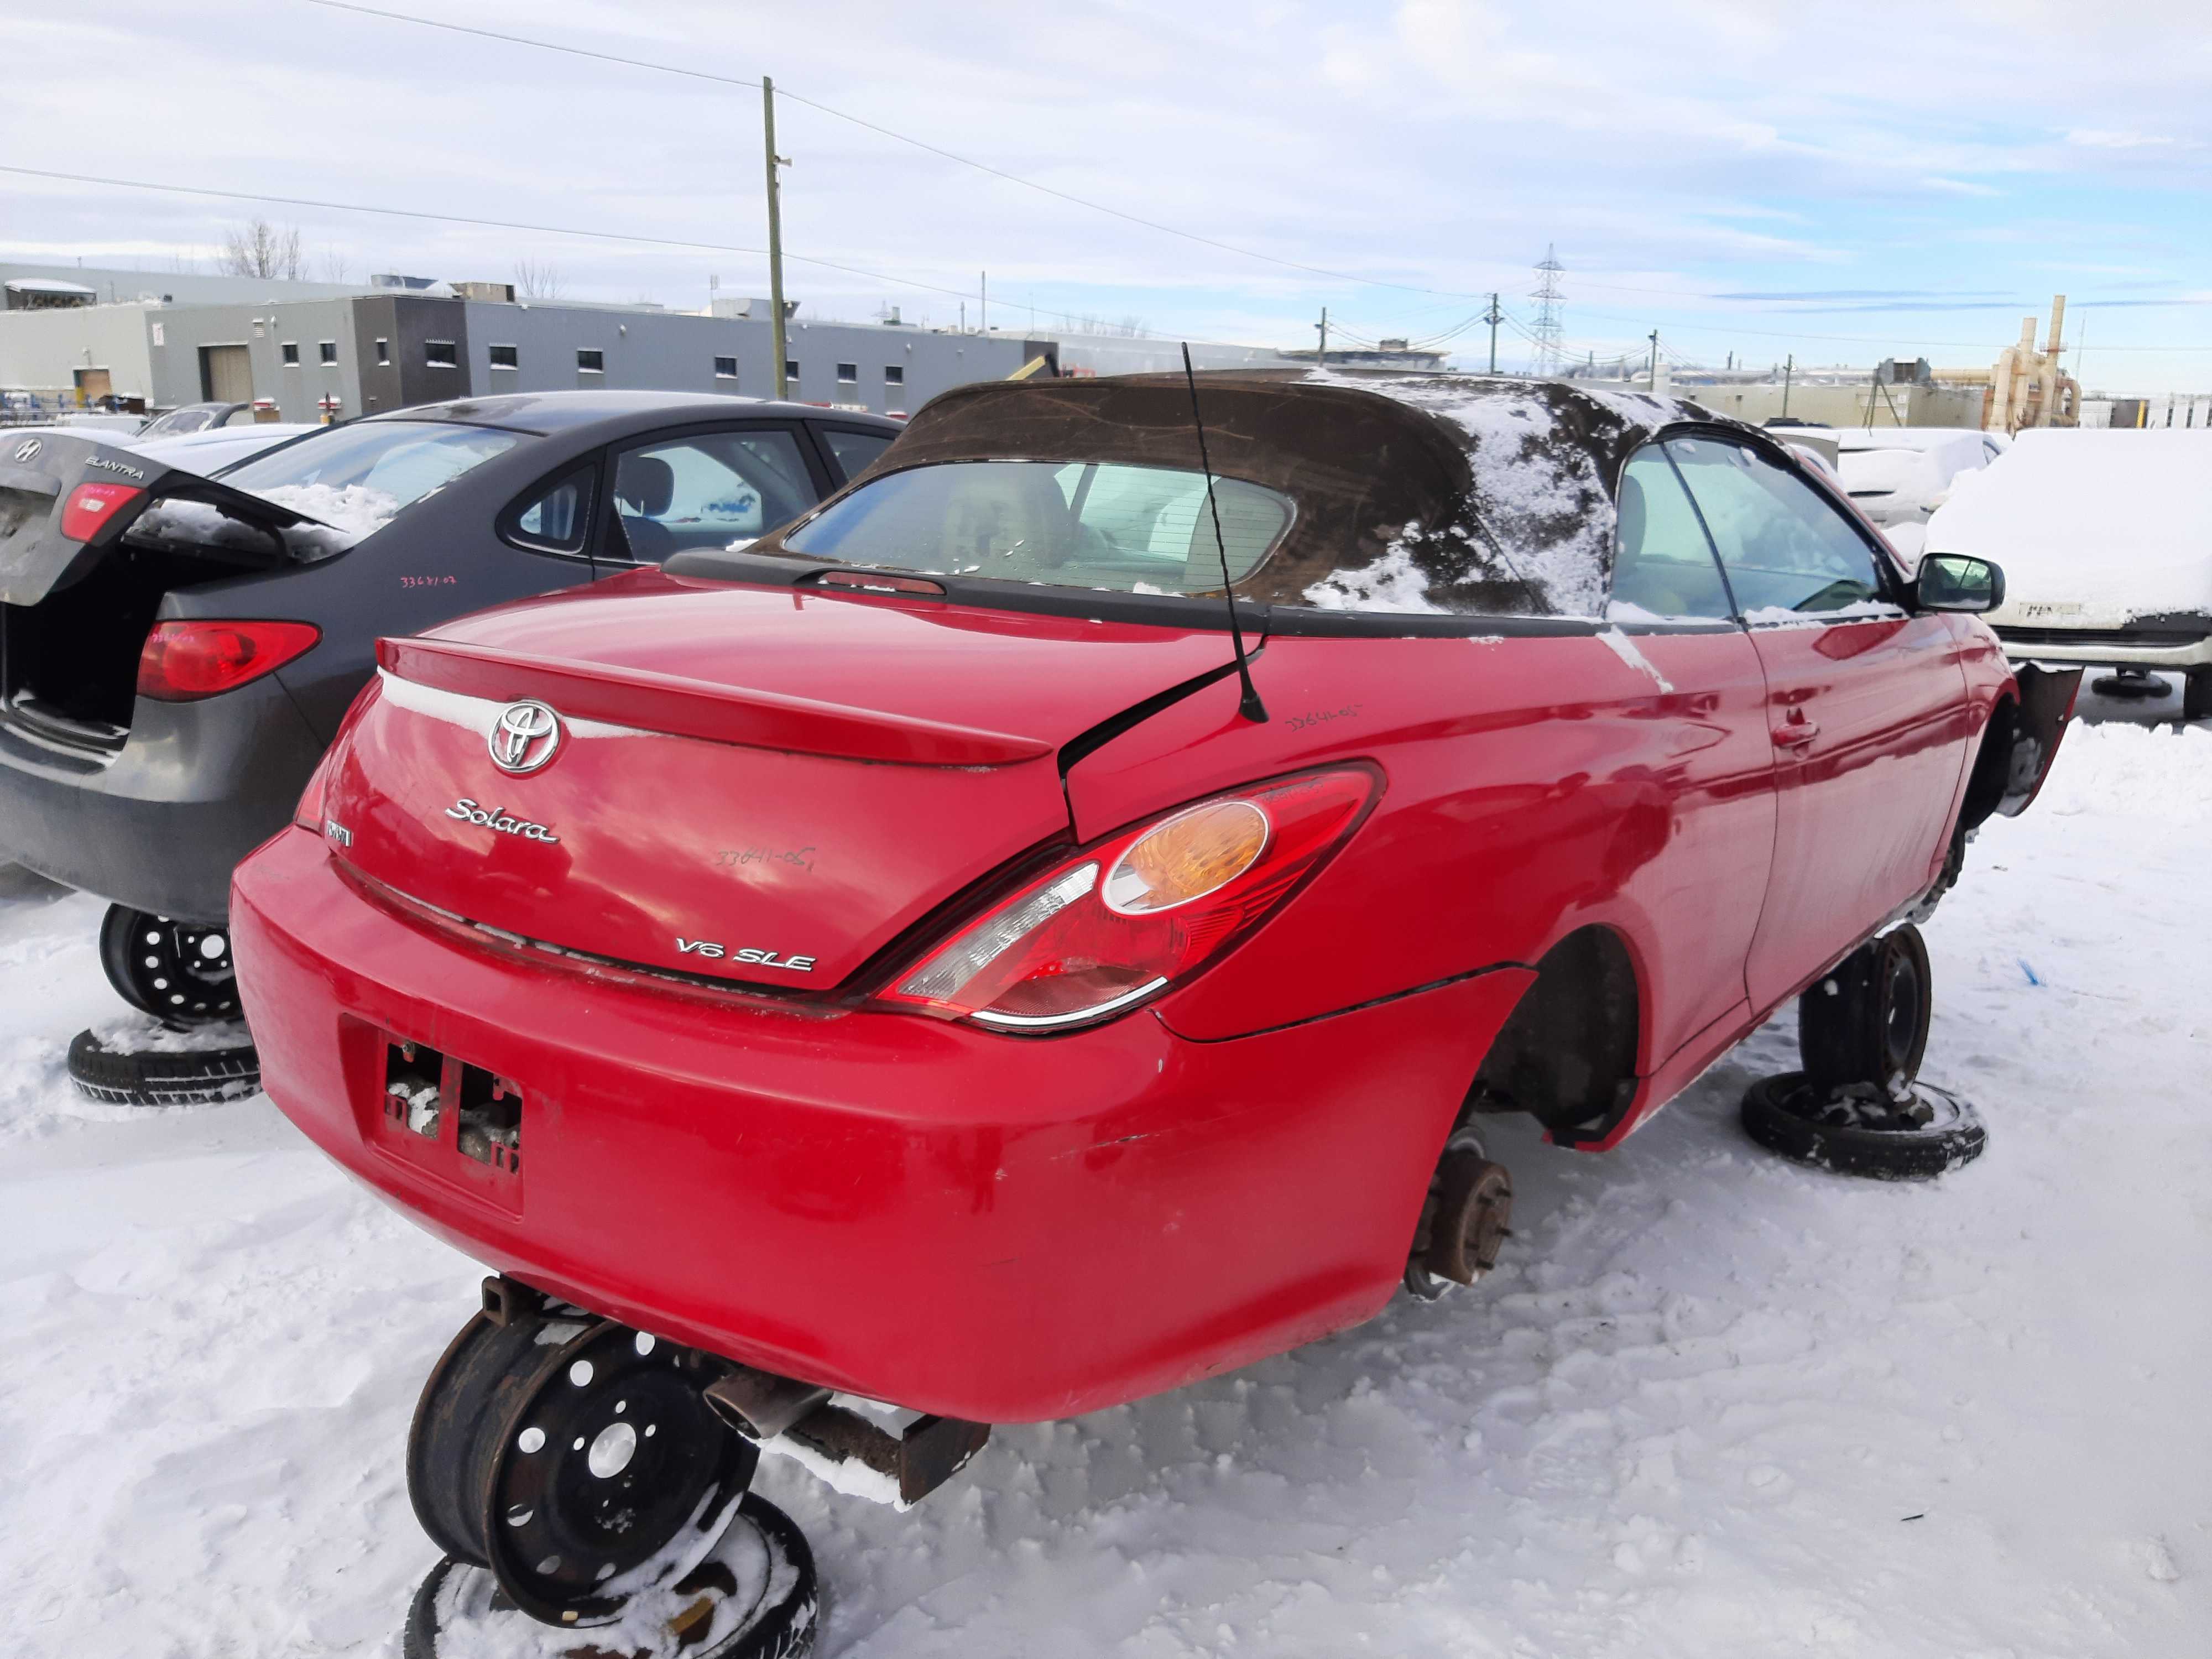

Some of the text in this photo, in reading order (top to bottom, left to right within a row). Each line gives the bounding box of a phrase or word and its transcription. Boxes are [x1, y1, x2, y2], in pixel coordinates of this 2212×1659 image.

[85, 456, 144, 480] ELANTRA
[445, 798, 560, 844] Solara
[676, 937, 816, 972] V6 SLE
